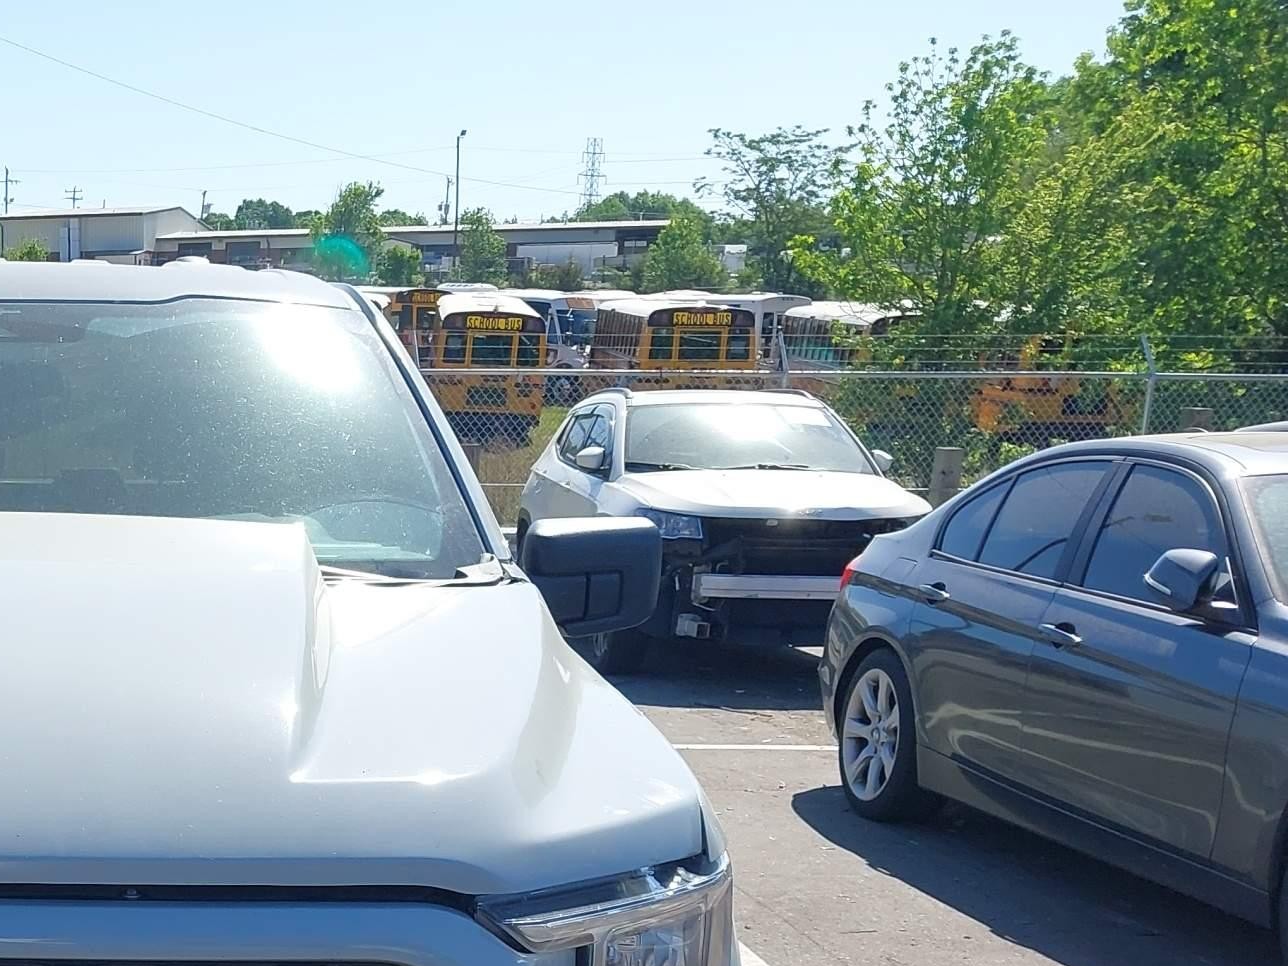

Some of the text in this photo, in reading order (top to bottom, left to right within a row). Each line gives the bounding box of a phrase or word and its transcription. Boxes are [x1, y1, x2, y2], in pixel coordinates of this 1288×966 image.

[468, 317, 522, 330] SCHOOL BUS
[675, 313, 707, 325] SCHOOL
